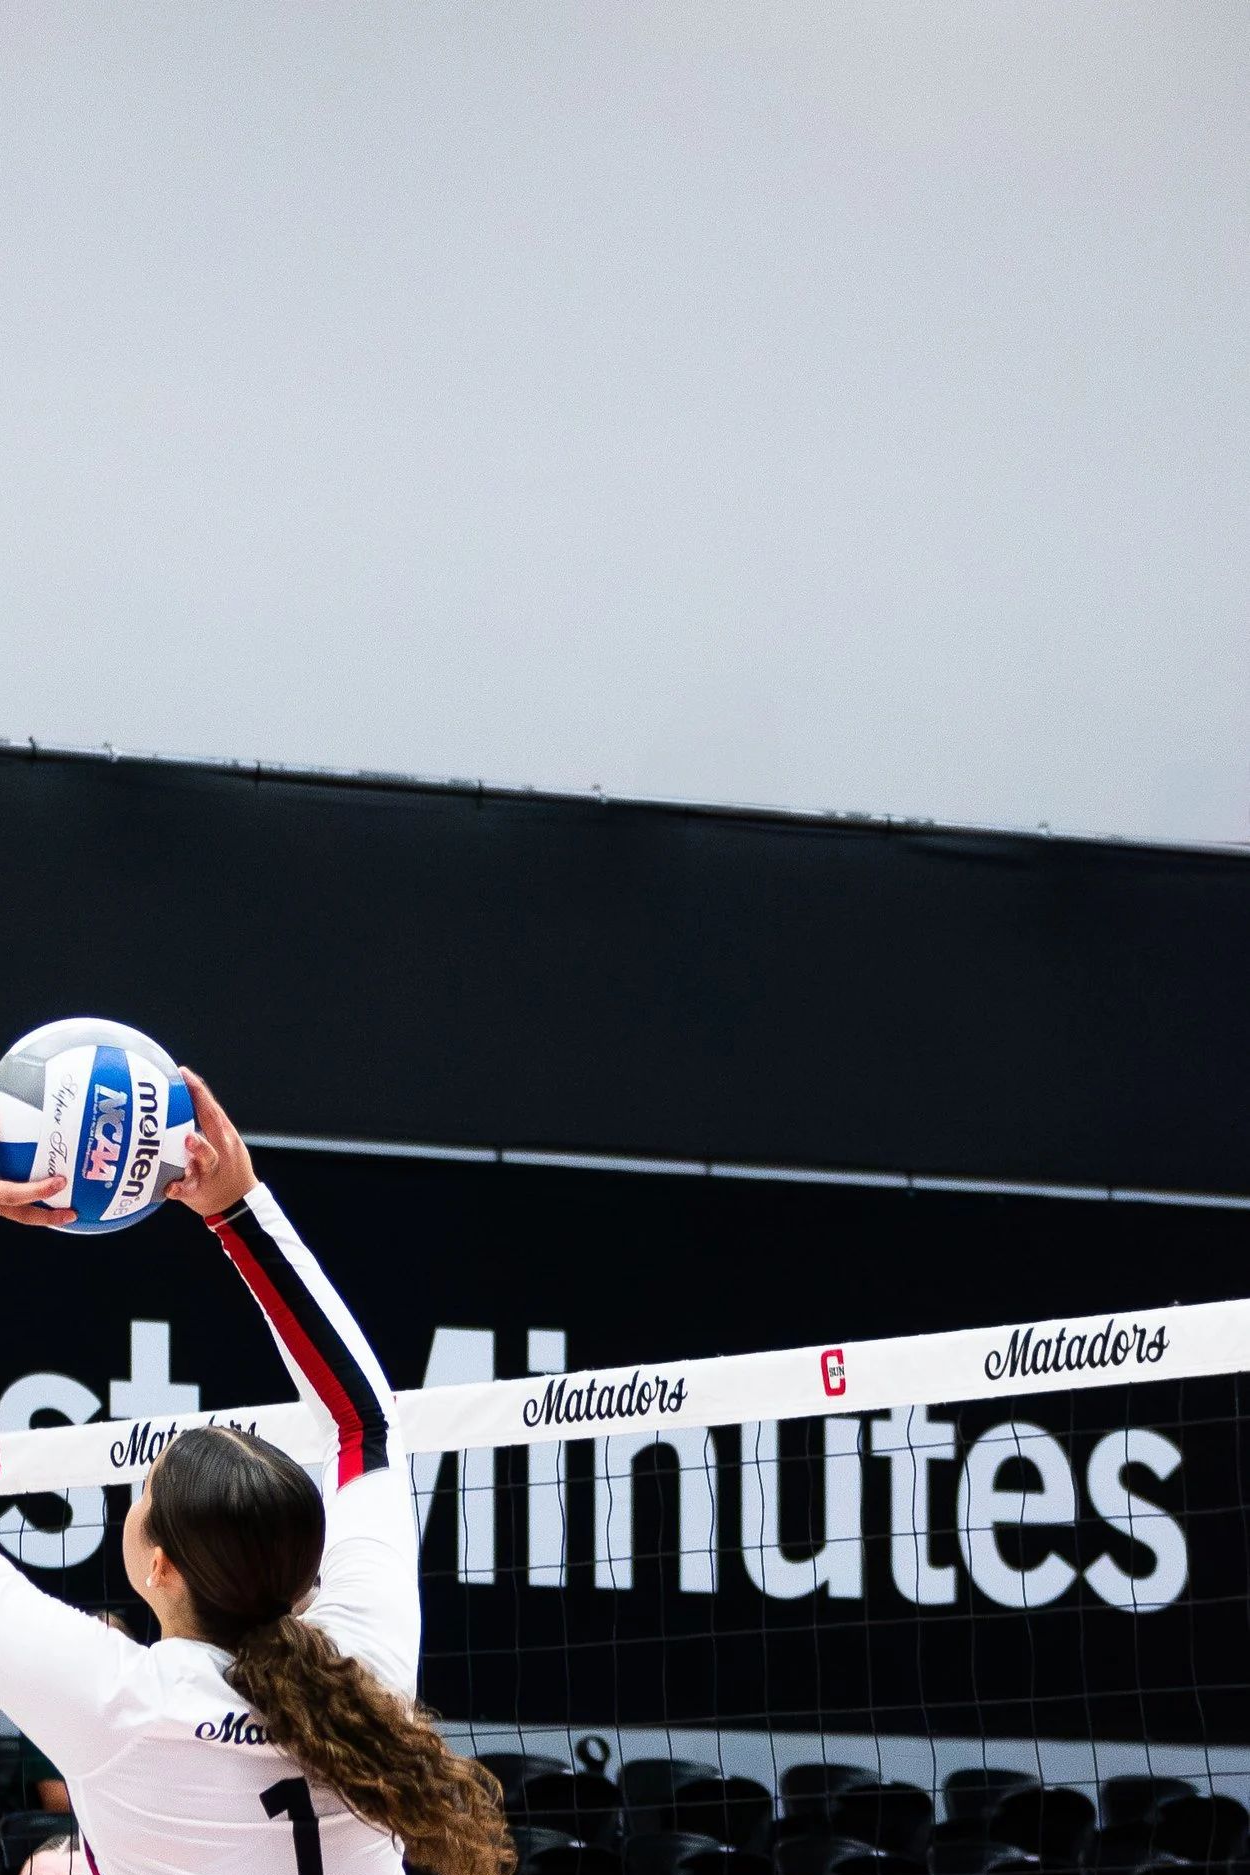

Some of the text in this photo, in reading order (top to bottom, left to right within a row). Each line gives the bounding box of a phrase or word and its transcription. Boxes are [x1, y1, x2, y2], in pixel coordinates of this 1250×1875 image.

[86, 1083, 128, 1181] NCAA
[121, 1082, 160, 1197] molten
[523, 1370, 688, 1428] Matadors
[984, 1318, 1171, 1381] Matadors
